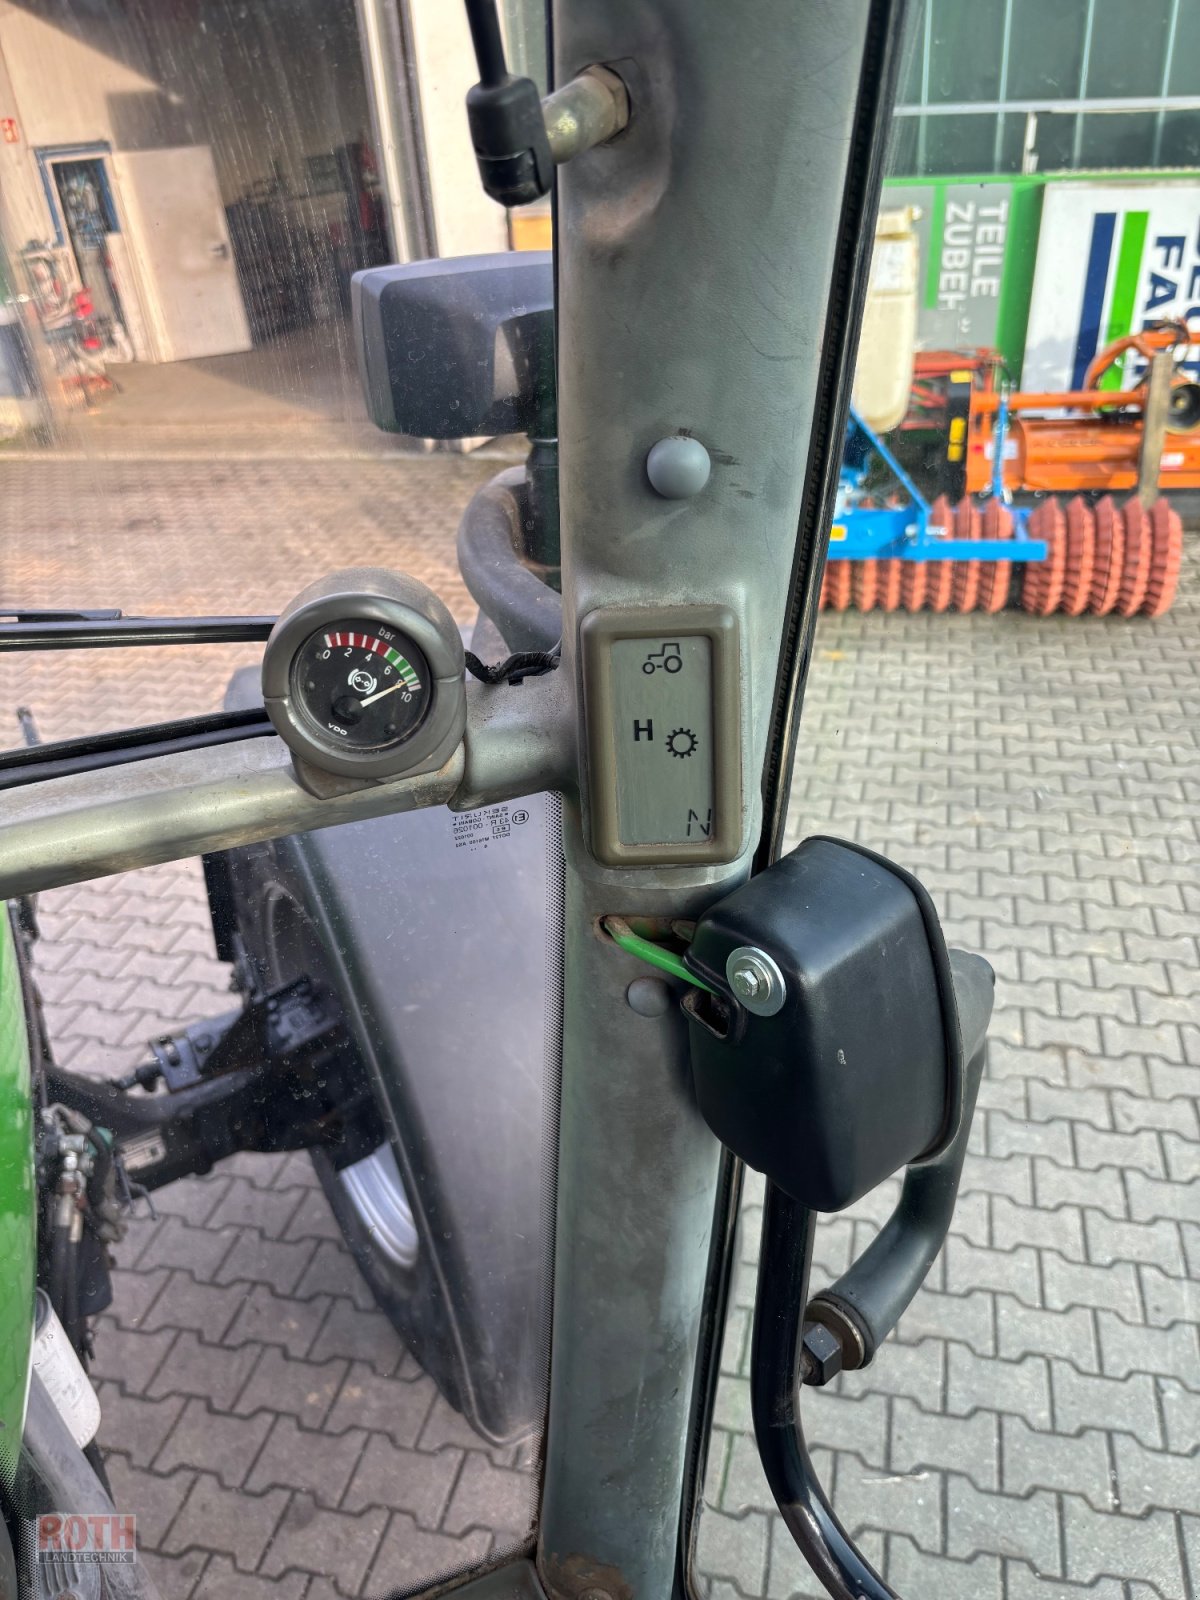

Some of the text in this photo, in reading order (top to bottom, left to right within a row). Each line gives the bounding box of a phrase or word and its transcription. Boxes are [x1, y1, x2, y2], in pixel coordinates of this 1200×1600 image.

[970, 200, 1009, 297] TEILE
[378, 626, 397, 642] bar
[322, 650, 331, 660] 0
[344, 647, 353, 658] 2
[365, 653, 373, 662] 4
[384, 665, 393, 676] 6
[400, 691, 412, 703] 10
[327, 722, 348, 736] VDO
[633, 719, 654, 742] H
[686, 808, 712, 836] N
